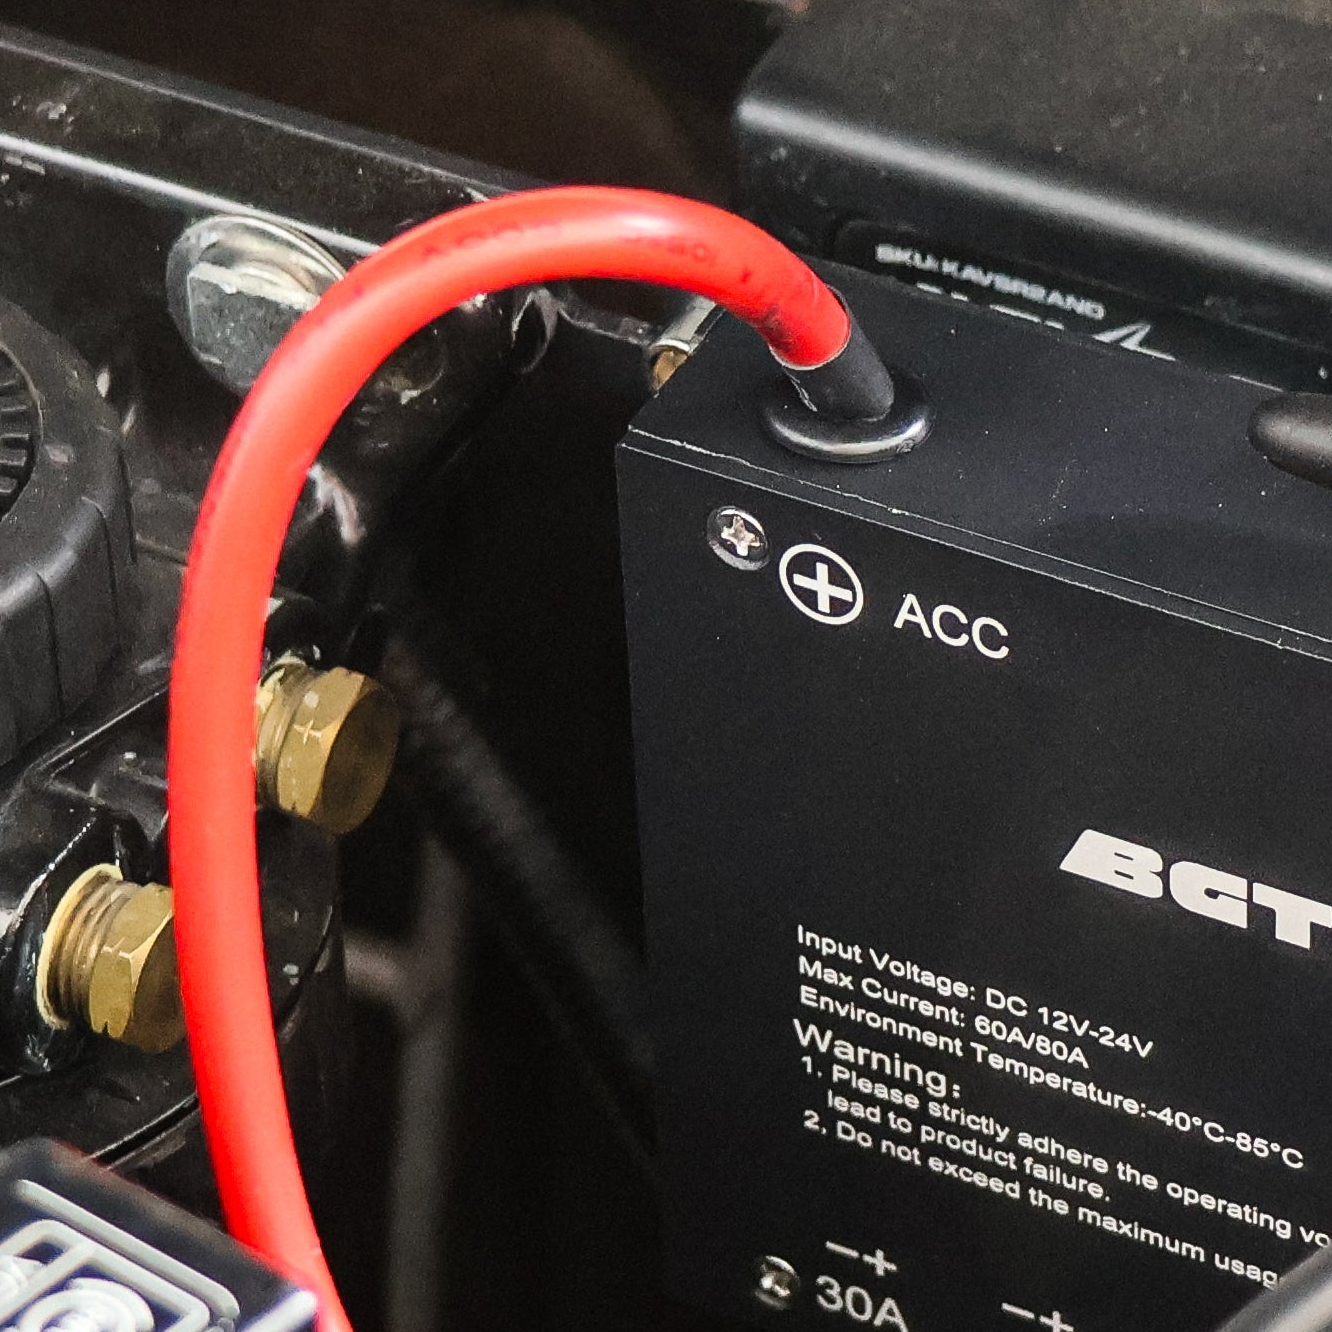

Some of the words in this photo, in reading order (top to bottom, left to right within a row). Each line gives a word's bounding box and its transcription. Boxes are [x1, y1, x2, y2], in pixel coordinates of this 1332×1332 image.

[893, 591, 1011, 661] ACC
[797, 924, 863, 964] Input
[869, 948, 976, 1001] Voltage:
[985, 986, 1029, 1017] DC
[1037, 1006, 1154, 1058] 12V-24V
[798, 955, 854, 990] Max
[861, 977, 966, 1028] Current:
[974, 1015, 1090, 1069] 60A/80A
[799, 984, 963, 1057] Environment
[800, 1055, 823, 1079] 1.
[832, 1063, 920, 1110] Please
[927, 1100, 1010, 1143] strictly
[1017, 1131, 1109, 1174] adhere
[1116, 1161, 1159, 1191] the
[1166, 1181, 1292, 1240] operating
[827, 1088, 881, 1124] lead
[886, 1110, 913, 1134] to
[920, 1124, 1018, 1170] product
[1023, 1156, 1111, 1202] failure.
[835, 1120, 873, 1148] Do
[880, 1138, 921, 1166] not
[927, 1156, 1021, 1199] exceed
[1028, 1186, 1069, 1216] the
[1077, 1206, 1206, 1263] maximum
